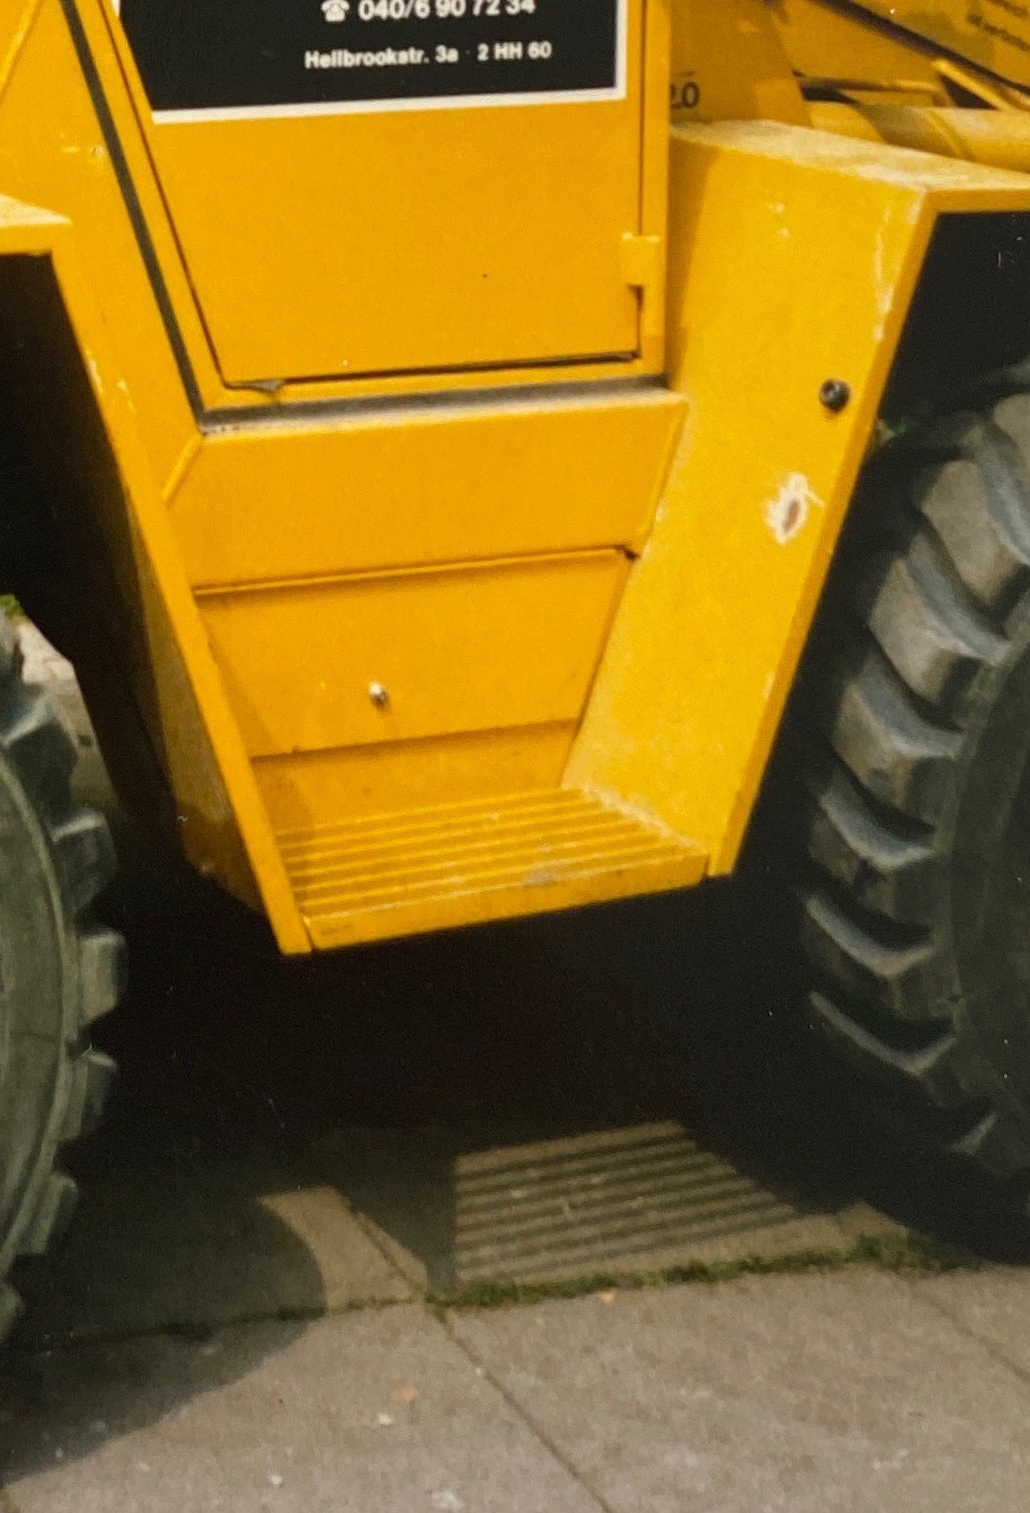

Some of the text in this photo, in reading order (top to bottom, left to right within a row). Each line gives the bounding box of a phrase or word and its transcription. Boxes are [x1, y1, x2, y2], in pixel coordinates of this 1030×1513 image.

[434, 44, 459, 64] 3a
[477, 42, 489, 62] 2
[493, 41, 523, 61] HH
[527, 40, 553, 60] 60
